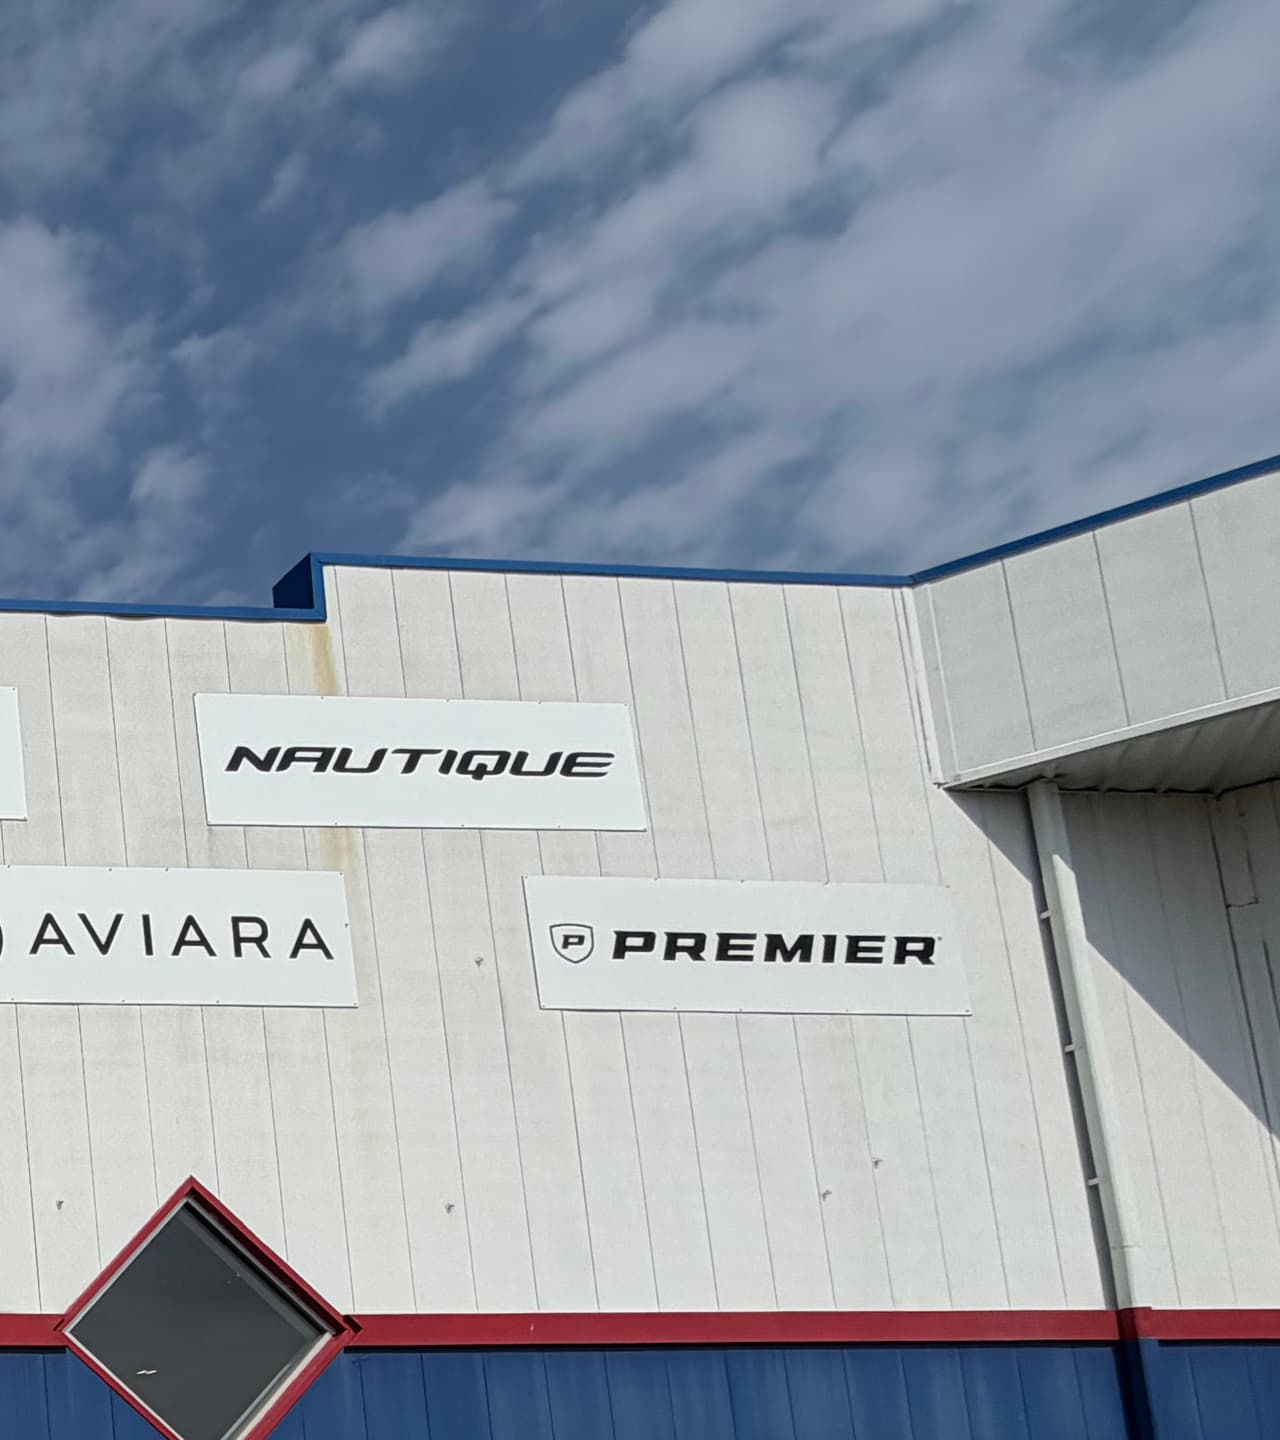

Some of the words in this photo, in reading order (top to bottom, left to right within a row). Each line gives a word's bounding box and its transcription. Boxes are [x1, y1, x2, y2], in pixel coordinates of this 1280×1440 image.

[224, 746, 616, 782] NAUTIQUE
[29, 912, 335, 960] AVIARA
[612, 930, 936, 966] PREMIER
